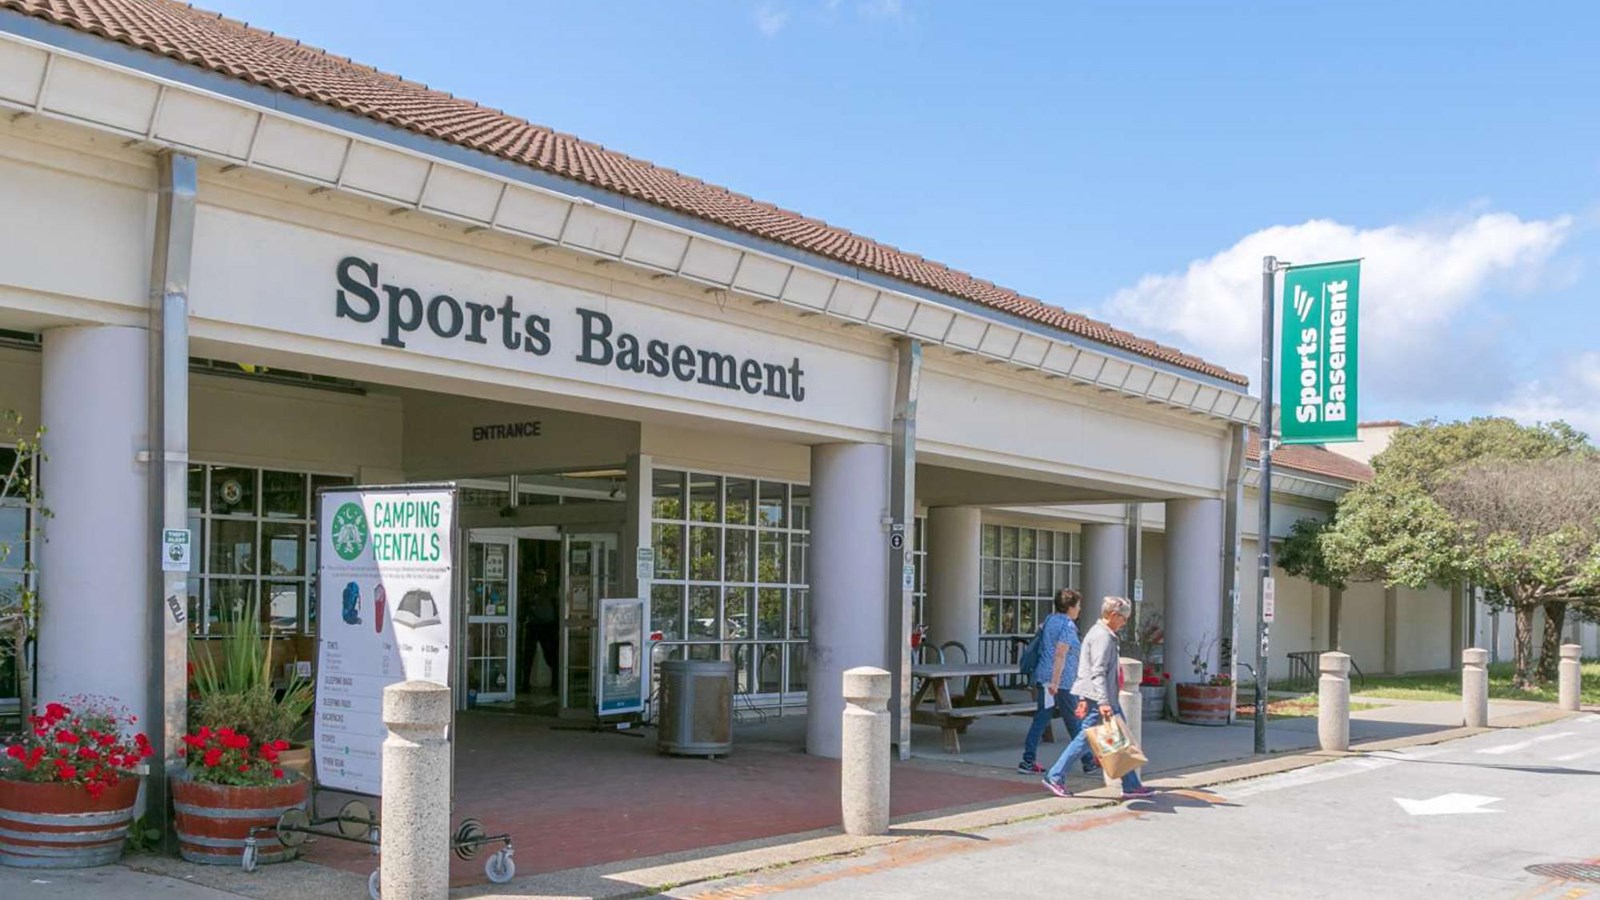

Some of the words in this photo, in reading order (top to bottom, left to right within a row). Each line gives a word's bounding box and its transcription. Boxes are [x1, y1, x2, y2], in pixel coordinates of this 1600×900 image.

[336, 256, 551, 356] Sports
[576, 308, 805, 403] Basement
[1325, 280, 1348, 421] Basement
[1296, 327, 1321, 423] Sports
[472, 421, 542, 441] ENTRANCE
[373, 501, 440, 528] CAMPING
[372, 533, 440, 562] RENTALS
